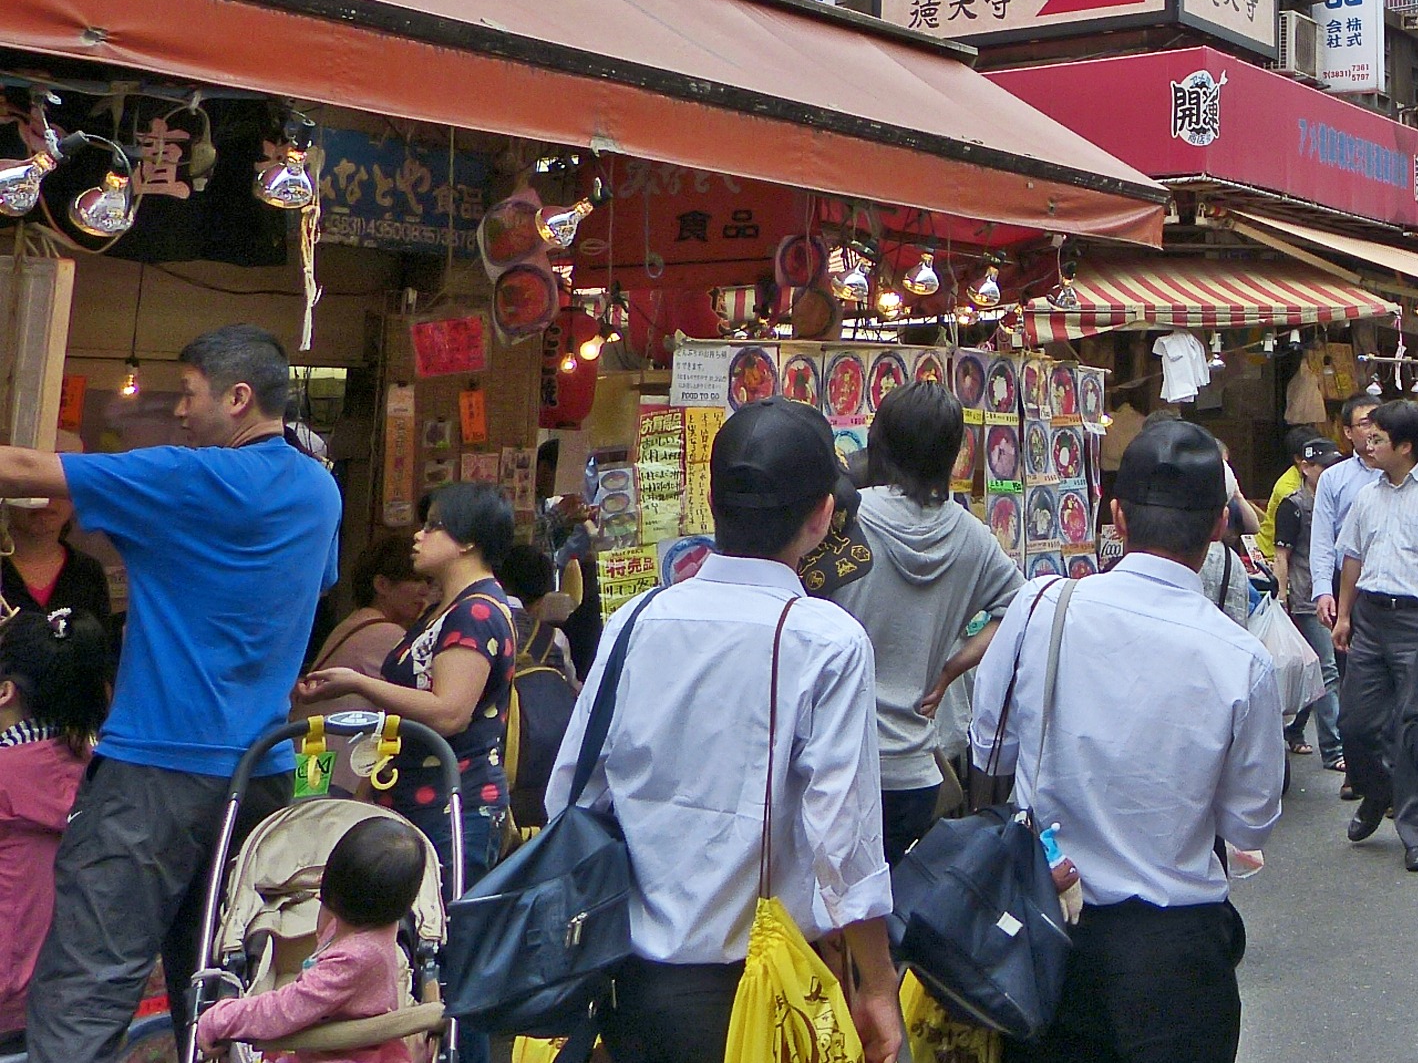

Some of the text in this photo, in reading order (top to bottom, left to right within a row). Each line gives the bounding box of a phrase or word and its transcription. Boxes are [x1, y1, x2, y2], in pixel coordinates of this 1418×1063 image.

[1325, 18, 1343, 49] 会社
[1345, 17, 1363, 48] 株式
[1171, 81, 1220, 139] 開運
[674, 209, 760, 243] 食品
[681, 392, 720, 400] FOOD TO GO
